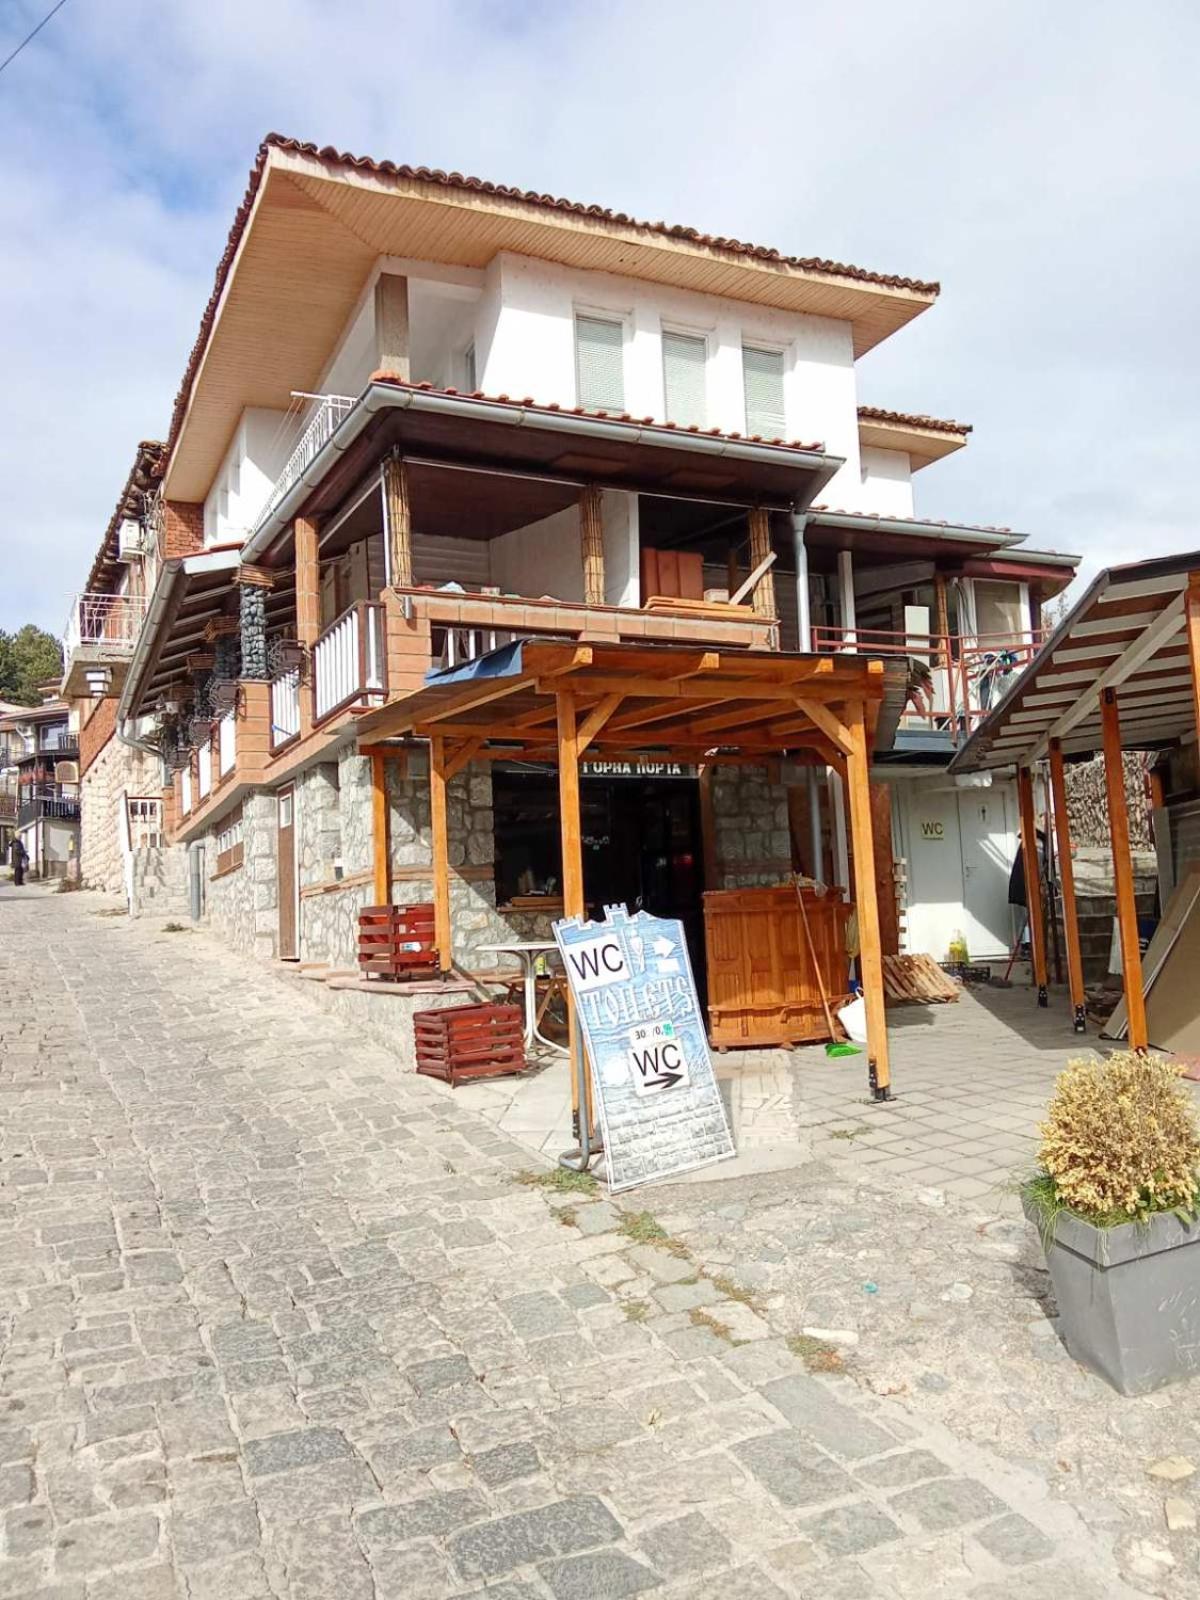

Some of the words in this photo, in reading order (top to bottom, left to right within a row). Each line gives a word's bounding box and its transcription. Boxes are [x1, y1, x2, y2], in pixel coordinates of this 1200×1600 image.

[583, 762, 631, 774] ГОРНА
[921, 822, 944, 835] WC
[569, 943, 624, 980] WC
[582, 976, 694, 1028] TOILETS
[635, 1029, 646, 1040] 30
[632, 1044, 681, 1077] WC
